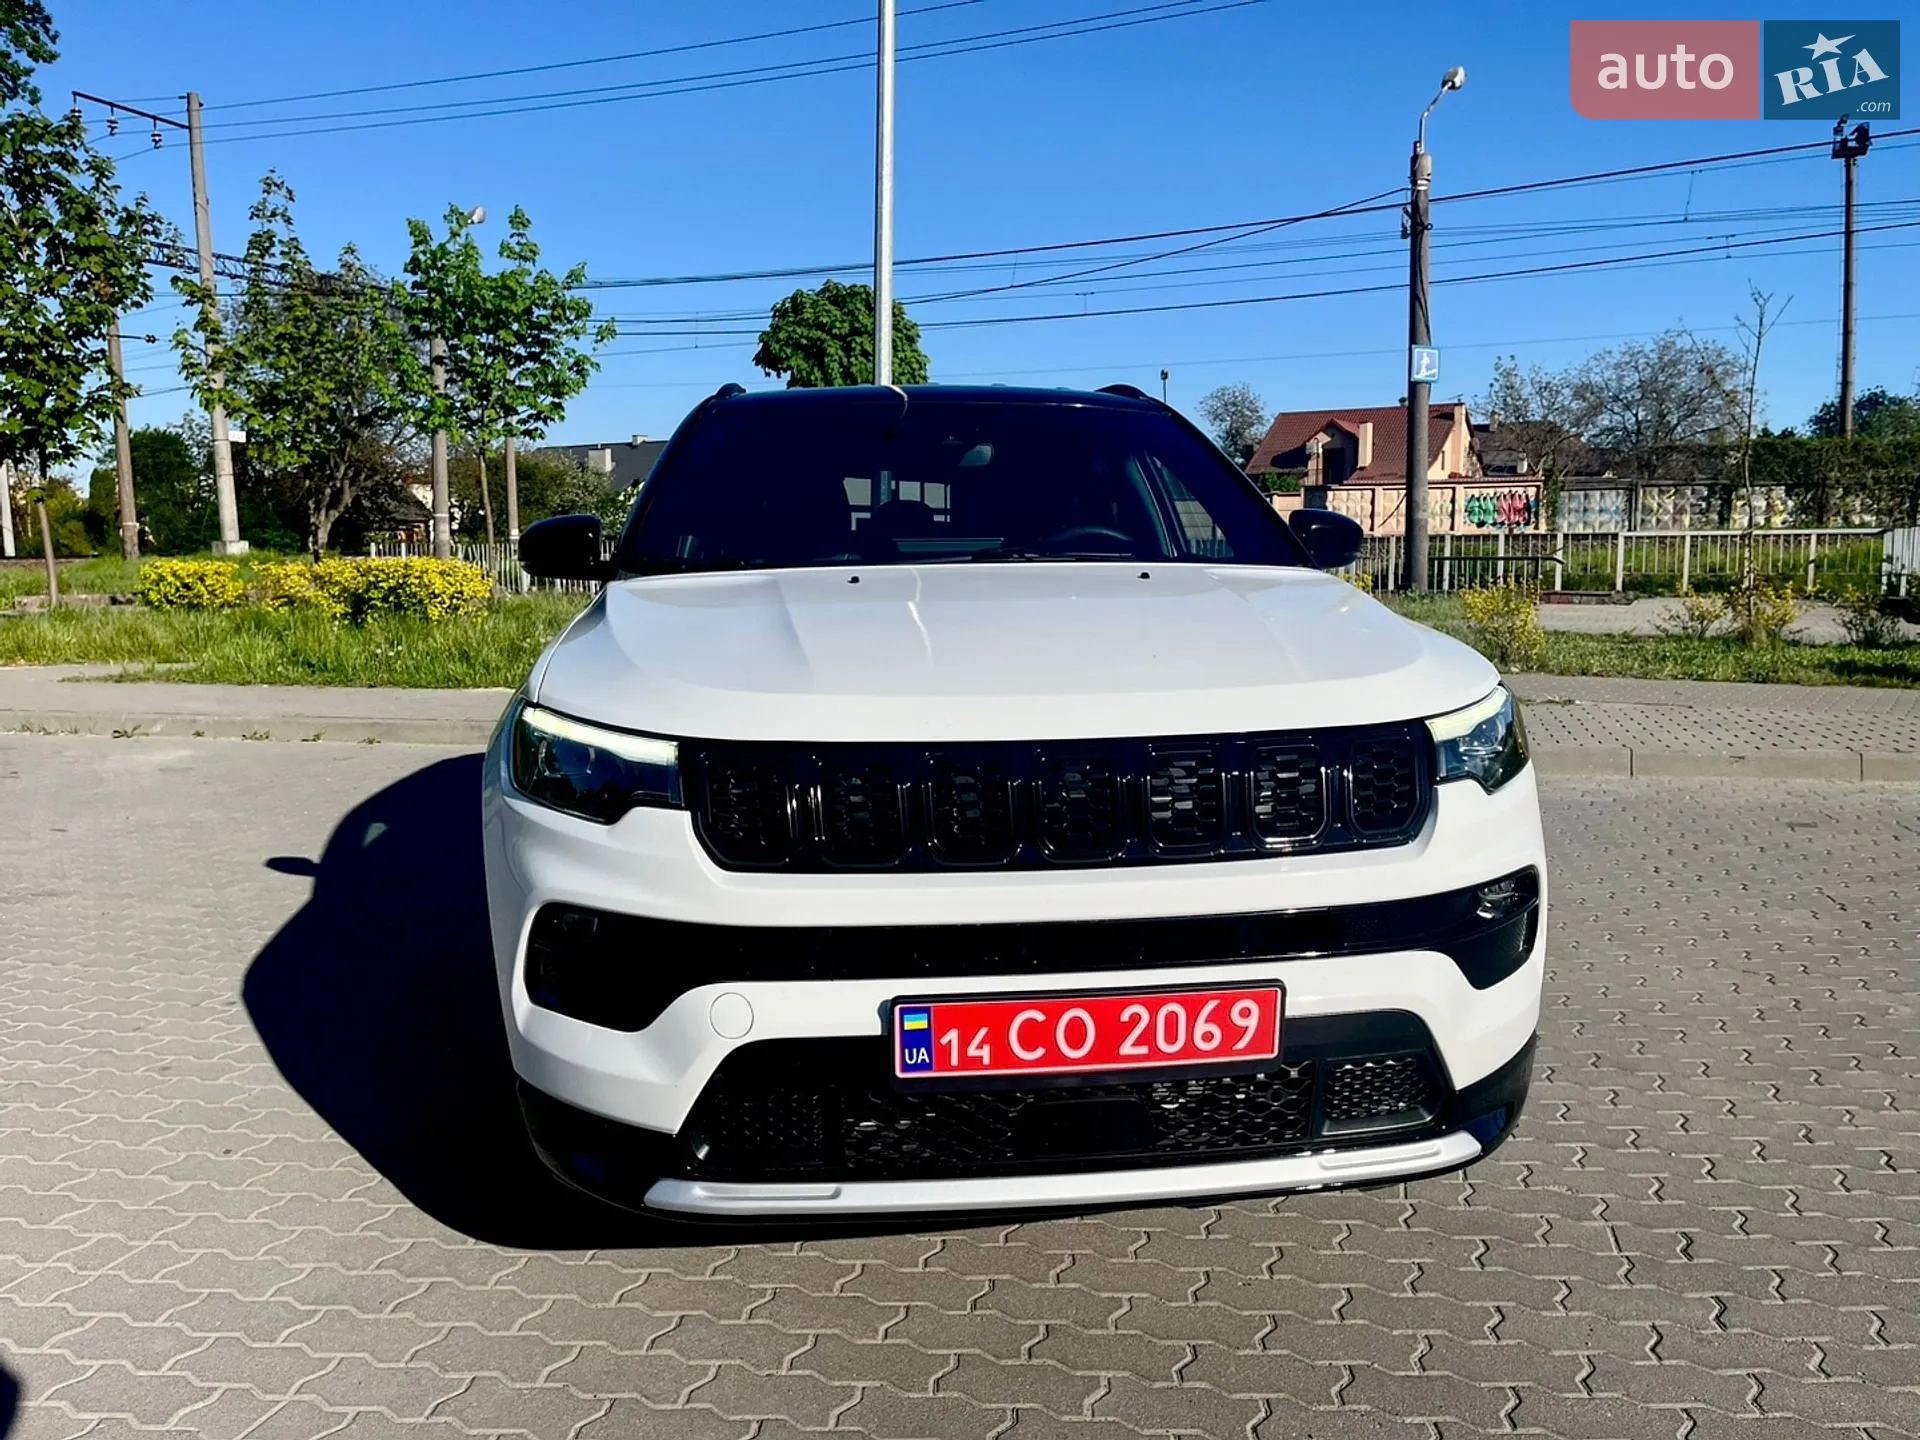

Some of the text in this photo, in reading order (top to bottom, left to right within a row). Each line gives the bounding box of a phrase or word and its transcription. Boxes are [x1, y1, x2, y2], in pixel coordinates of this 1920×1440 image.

[939, 999, 1260, 1067] 14 CO 2069
[905, 1048, 930, 1064] UA
